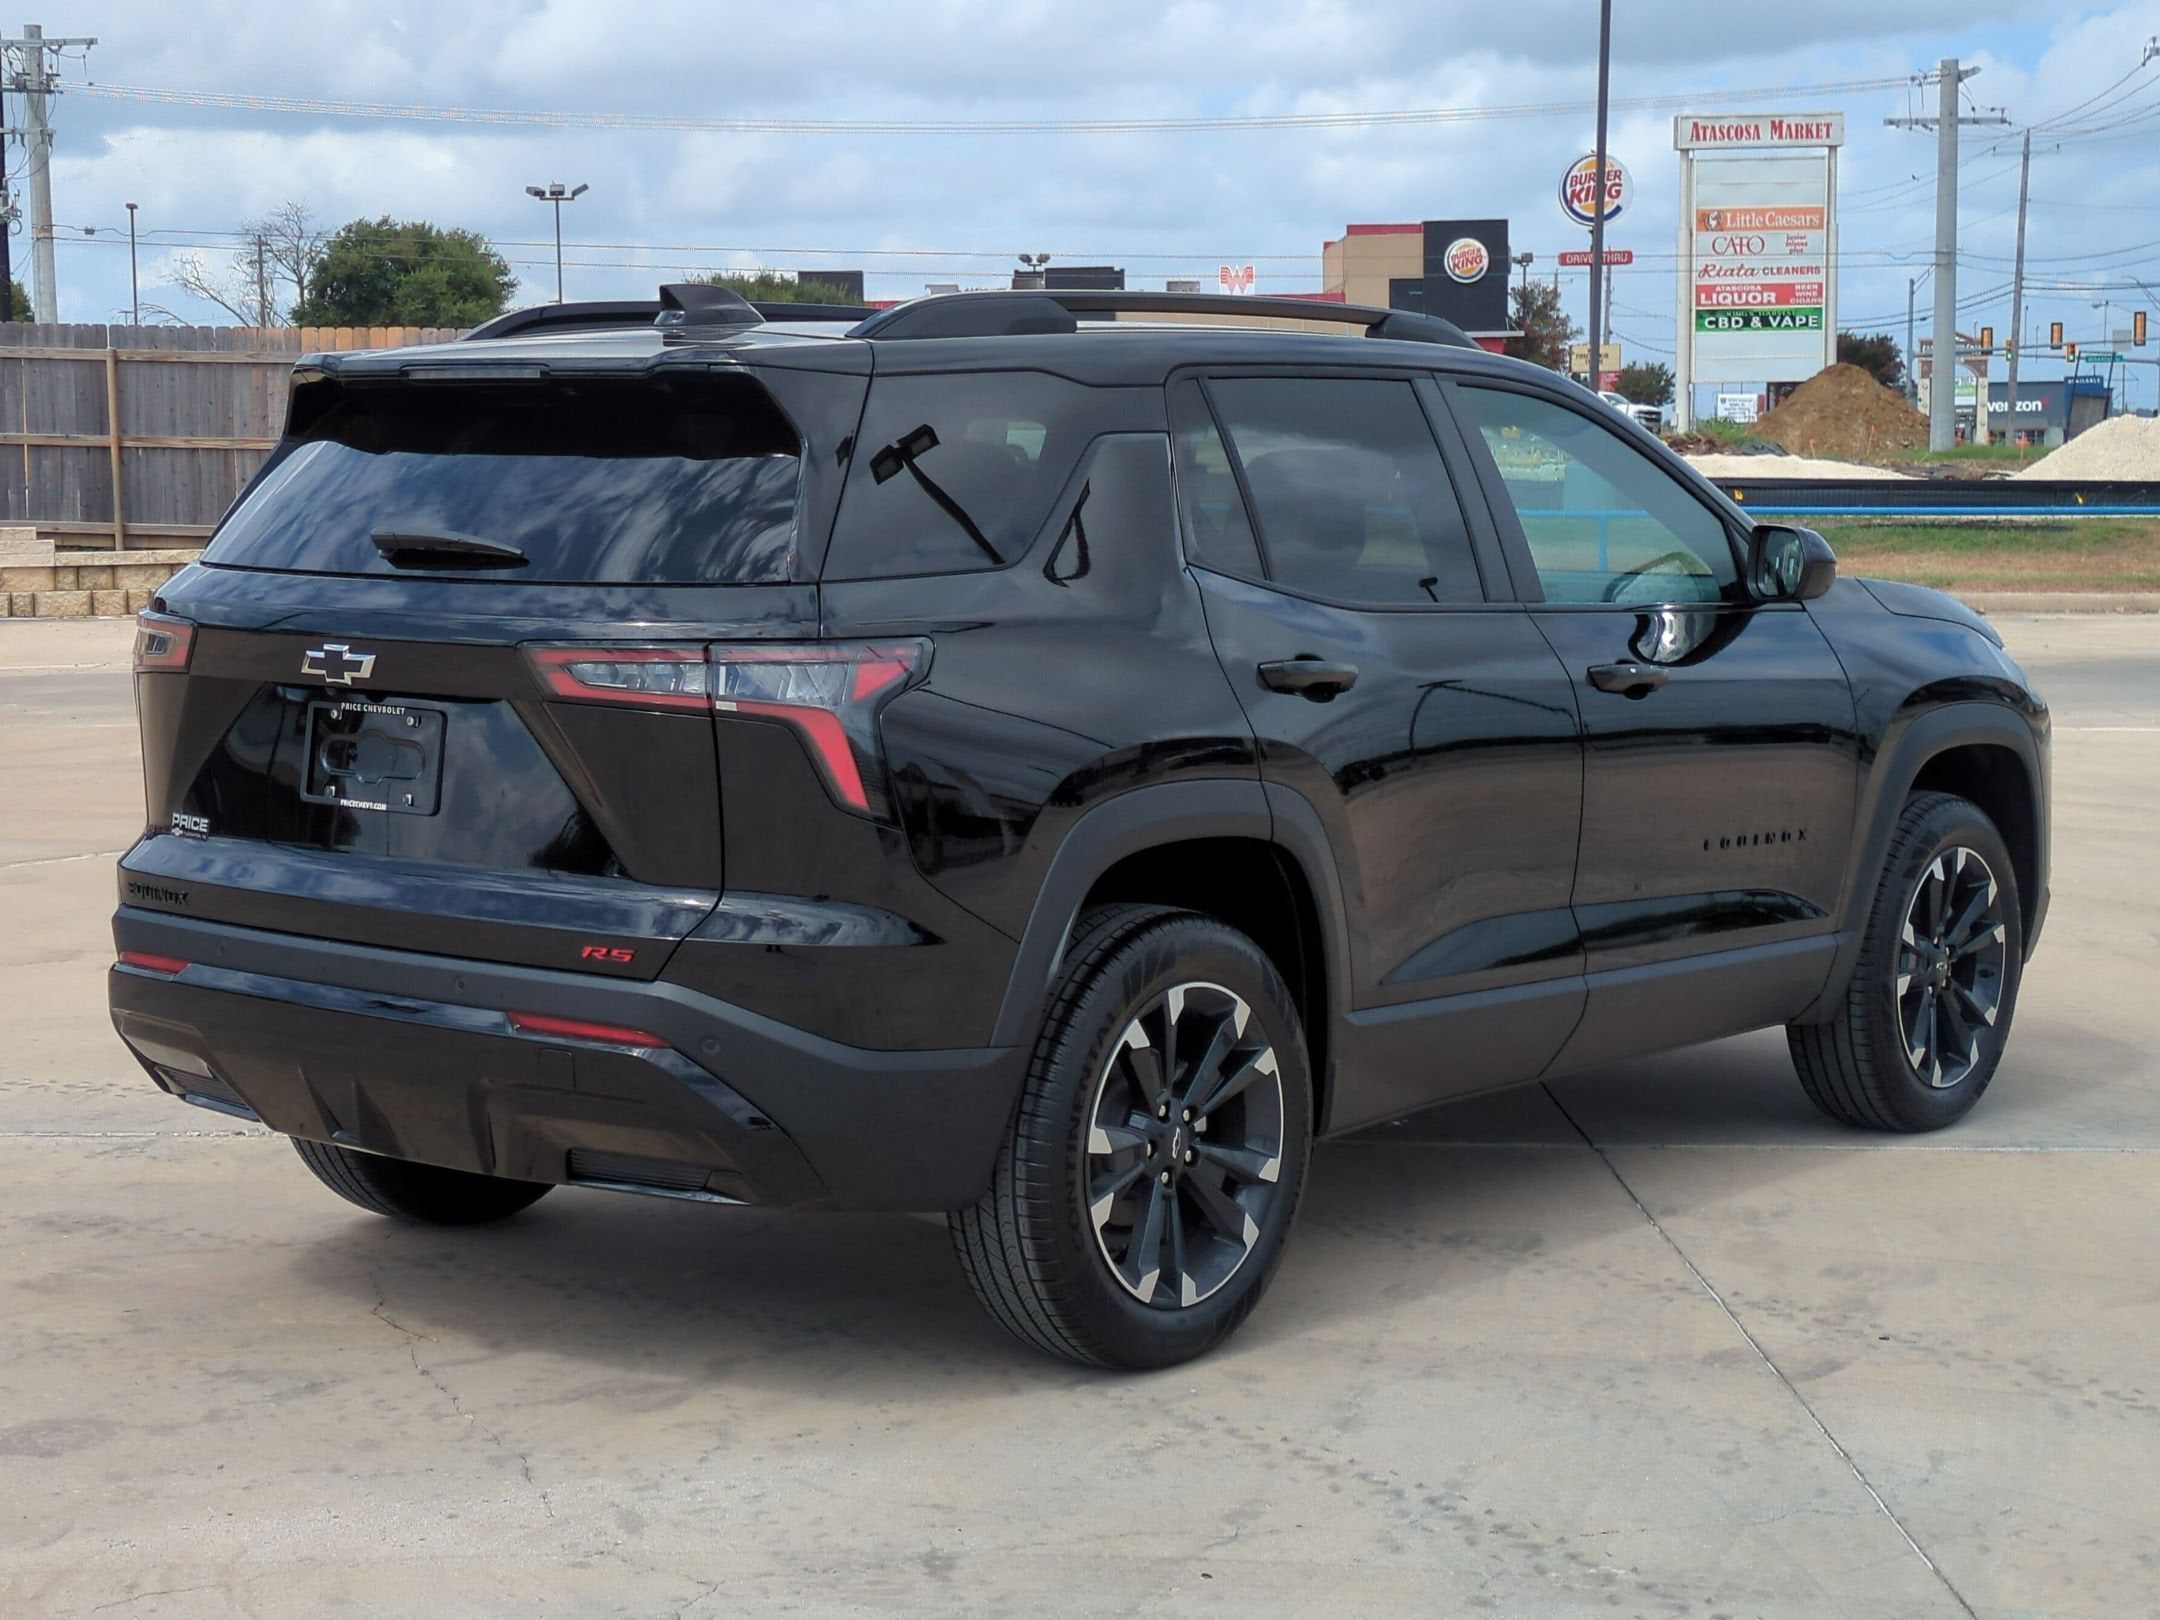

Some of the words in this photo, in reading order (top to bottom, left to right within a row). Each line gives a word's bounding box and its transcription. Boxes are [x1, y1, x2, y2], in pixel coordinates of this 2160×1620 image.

[1690, 120, 1761, 142] ATASCOSA
[1770, 119, 1833, 140] MARKET
[1569, 169, 1622, 188] BURER
[1726, 212, 1763, 228] Little
[1765, 211, 1819, 227] Caesars
[1451, 247, 1482, 260] BURGER
[1712, 235, 1765, 256] CATO
[1452, 255, 1483, 272] KING
[1602, 253, 1628, 263] THRU
[1698, 263, 1760, 279] Riata
[1762, 266, 1821, 276] CLEANERS
[1700, 291, 1777, 306] LIQUOR
[1704, 316, 1744, 329] CBD
[1750, 315, 1762, 328] &
[1769, 315, 1819, 327] VAPE
[1987, 400, 2042, 413] verzon
[340, 702, 361, 712] PRICE
[363, 704, 405, 715] CHEVROLET
[171, 812, 209, 833] PRICE
[1703, 828, 1808, 852] EQUINOX
[582, 945, 634, 962] RS
